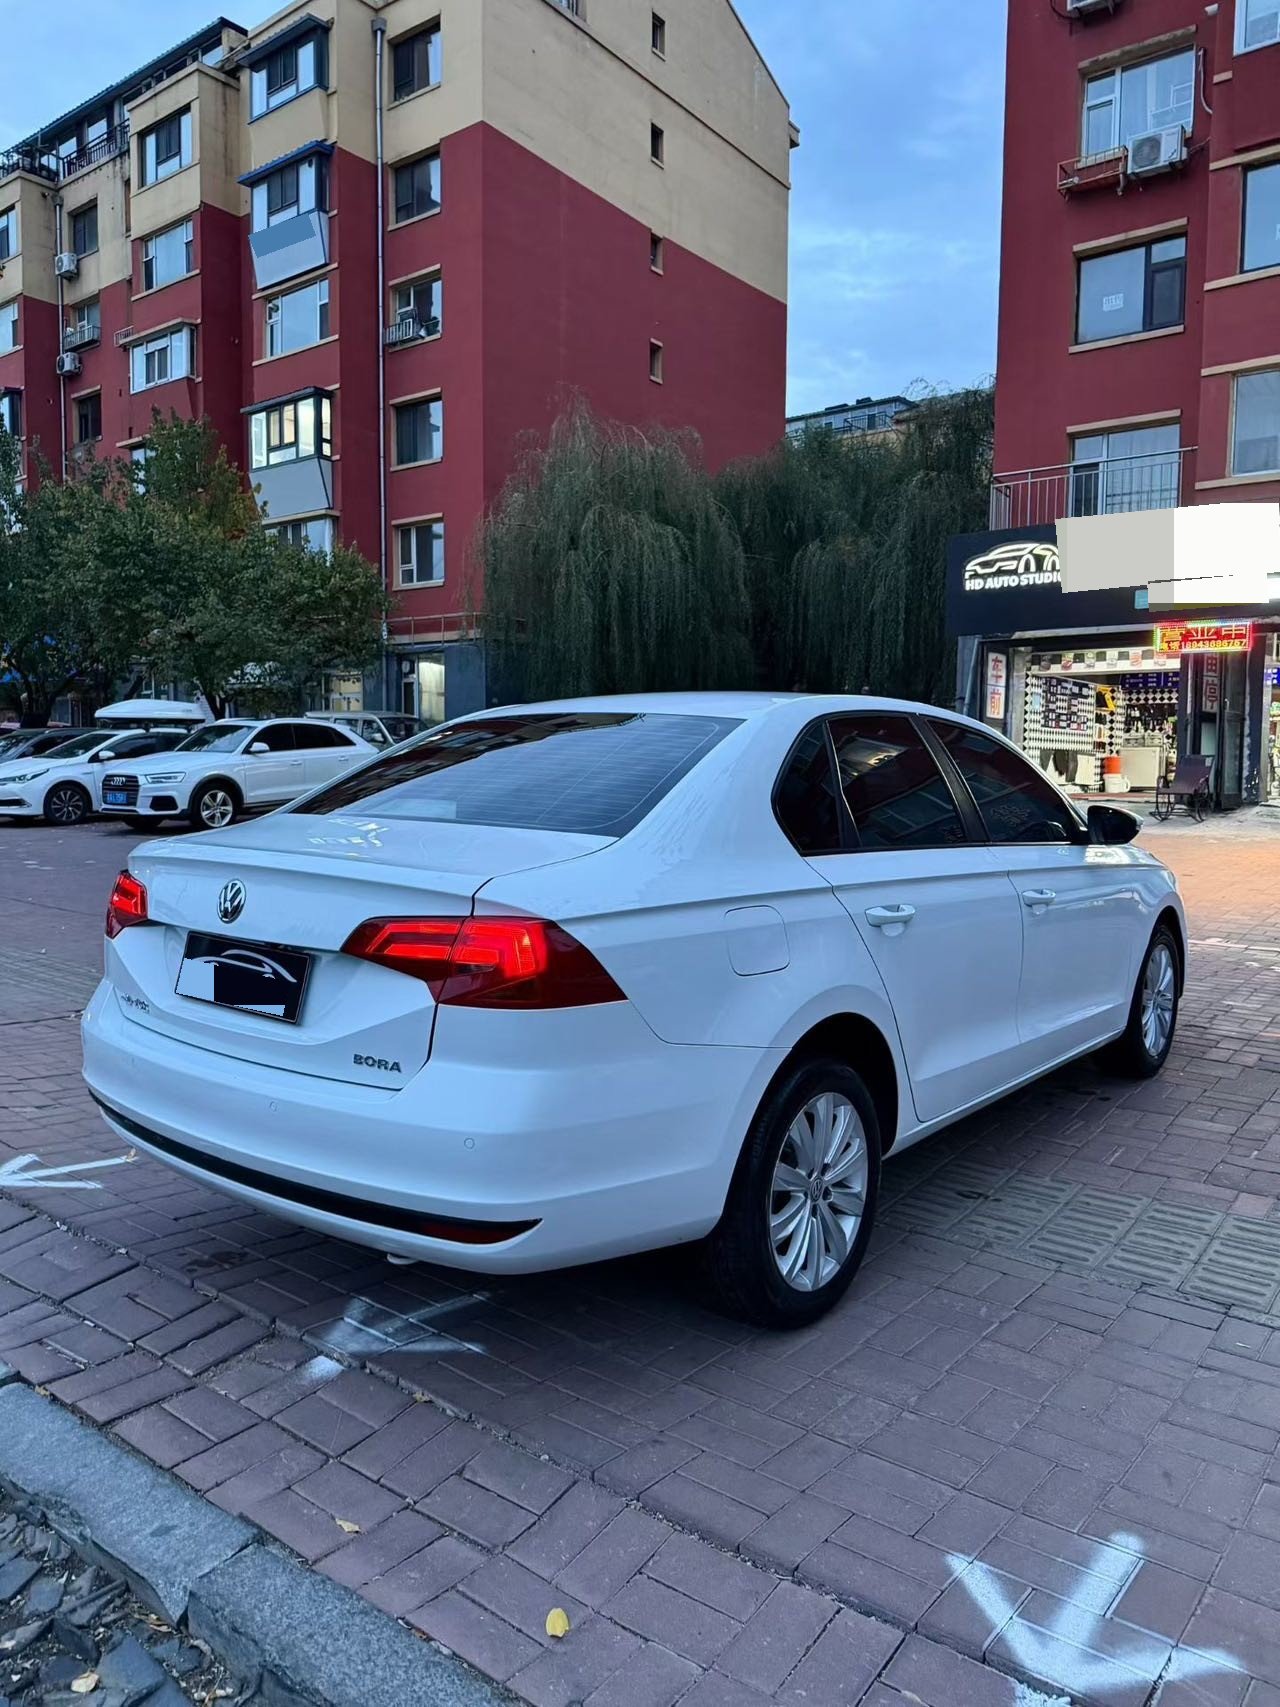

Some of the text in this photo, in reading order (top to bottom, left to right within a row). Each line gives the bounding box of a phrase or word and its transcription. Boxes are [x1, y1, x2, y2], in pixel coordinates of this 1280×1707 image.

[965, 578, 985, 591] HD
[985, 575, 1020, 590] AUTO
[1159, 624, 1246, 642] 营业中
[353, 1053, 402, 1073] BORA
